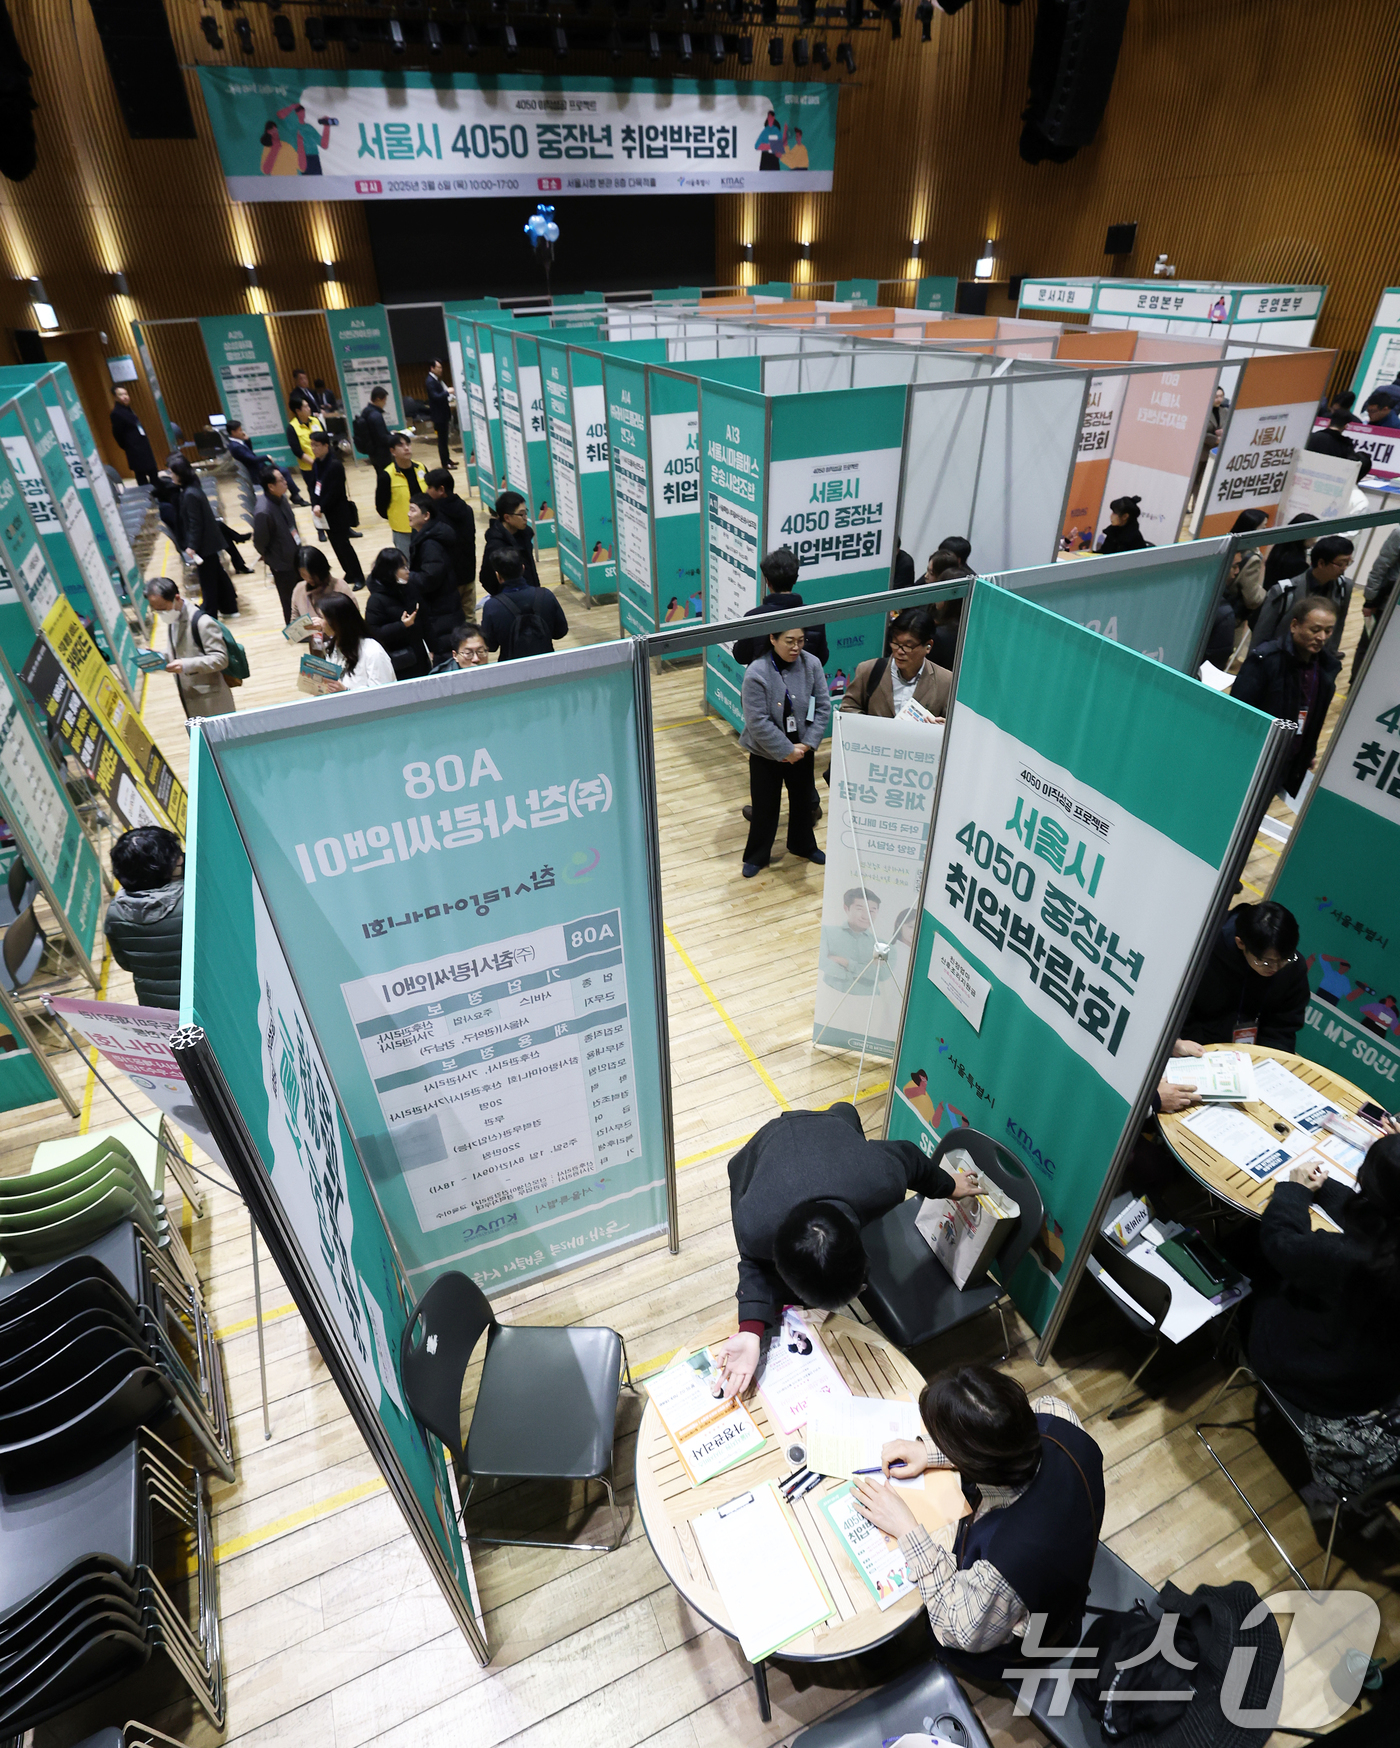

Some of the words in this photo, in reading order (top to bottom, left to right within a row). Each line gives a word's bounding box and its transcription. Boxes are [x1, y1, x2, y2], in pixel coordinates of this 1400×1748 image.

[515, 99, 536, 110] 4050
[358, 122, 443, 160] 서울시
[451, 124, 529, 159] 4050
[536, 123, 614, 159] 중장년
[621, 124, 738, 159] 취업박람회
[360, 181, 378, 192] 일시
[387, 180, 420, 191] 2025년
[541, 179, 558, 190] 장소
[566, 178, 597, 189] 서울시청
[628, 177, 657, 188] 다목적홀
[720, 177, 745, 185] KMAC
[1038, 288, 1076, 303] 문서지원
[1137, 294, 1184, 311] 운영본부
[1258, 296, 1303, 314] 운영본부
[726, 424, 740, 444] A13
[1250, 426, 1287, 446] 서울시
[707, 440, 760, 479] 서울시마을버스
[1226, 452, 1260, 472] 4050
[1260, 447, 1294, 468] 중장년
[711, 464, 756, 502] 운송사업조합
[809, 477, 860, 504] 서울시
[1217, 471, 1288, 502] 취업박람회
[780, 510, 829, 535] 4050
[834, 502, 884, 529] 중장년
[836, 634, 865, 647] KMAC
[96, 739, 118, 798] 커넥티드
[1020, 769, 1041, 791] 4050
[1041, 783, 1073, 815] 이직성공
[1073, 804, 1111, 837] 프로젝트
[1005, 796, 1106, 899] 서울시
[955, 820, 1036, 903] 4050
[1041, 879, 1146, 997] 중장년
[1330, 908, 1389, 950] 서울특별시
[944, 862, 1131, 1057] 취업박람회
[1323, 1022, 1356, 1050] MY
[1350, 1041, 1396, 1083] SOUL
[948, 1053, 996, 1109] 서울특별시
[1006, 1117, 1057, 1176] KMAC
[691, 1420, 746, 1462] 가정관리사
